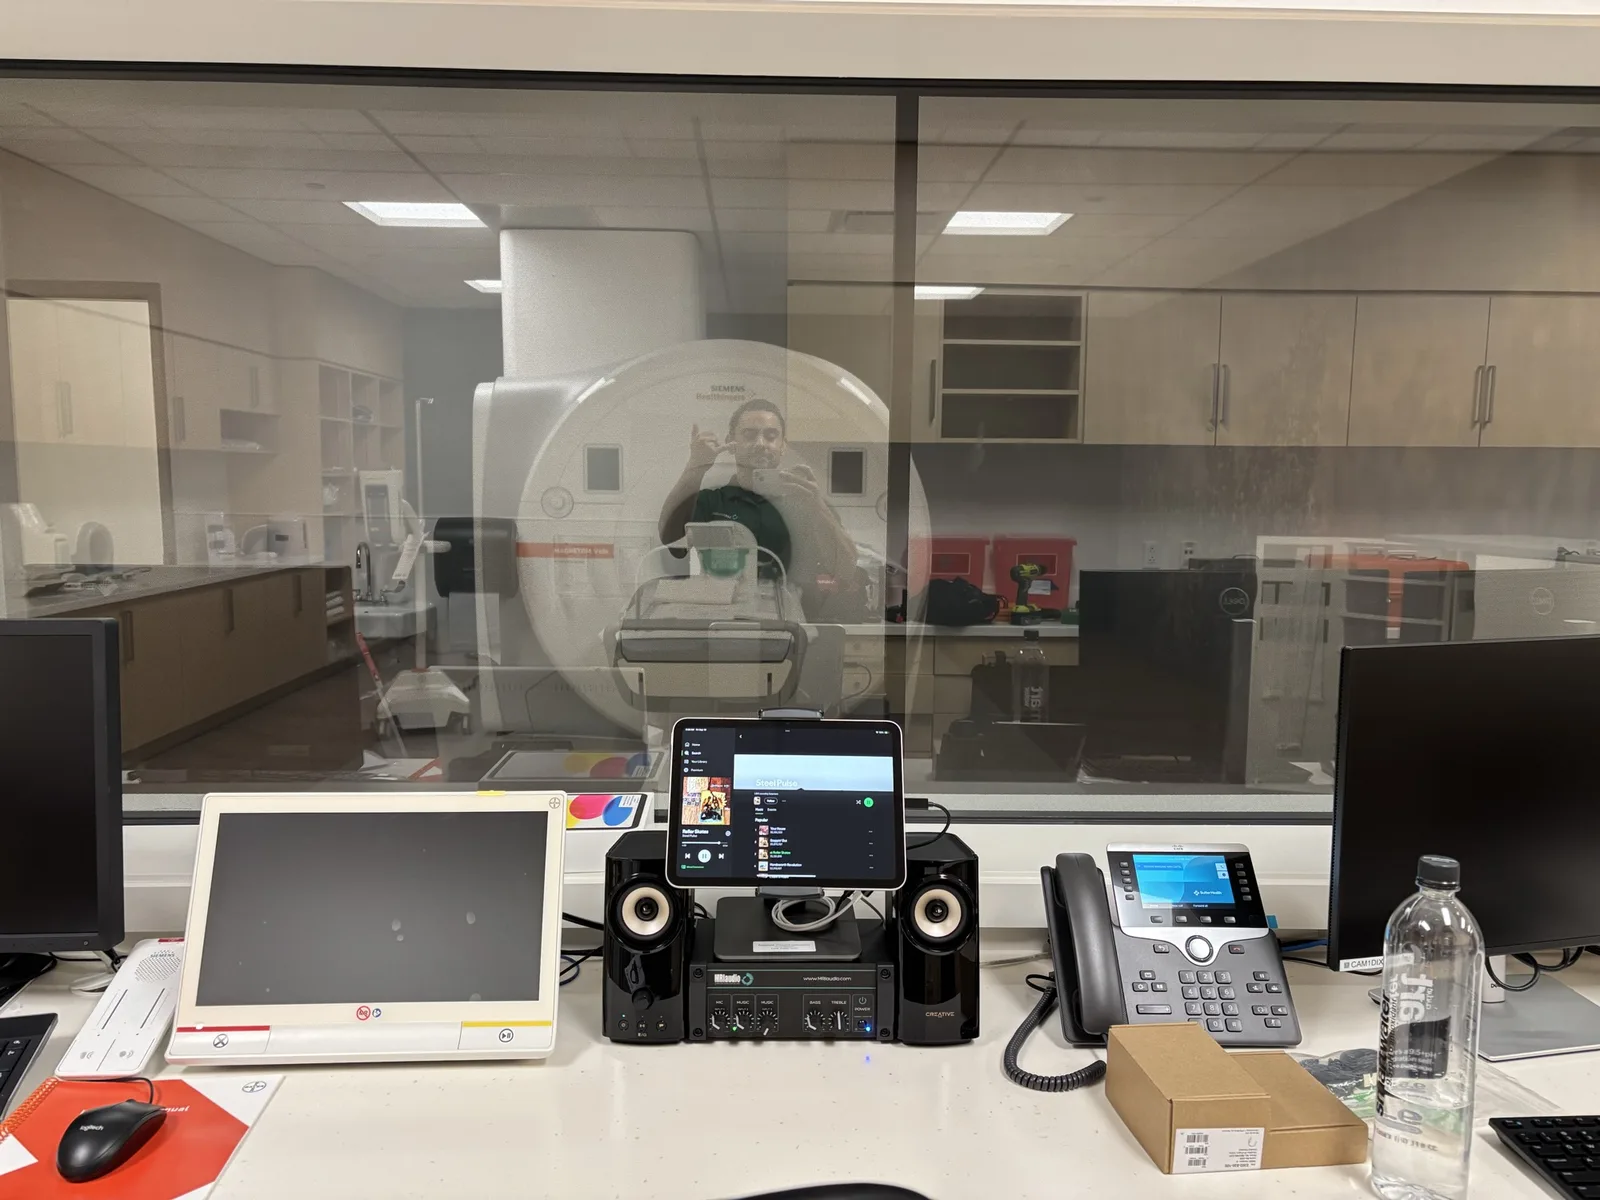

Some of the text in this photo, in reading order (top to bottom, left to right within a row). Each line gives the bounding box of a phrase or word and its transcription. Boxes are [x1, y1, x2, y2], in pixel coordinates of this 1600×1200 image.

[755, 778, 799, 787] Steel Pulse
[714, 973, 741, 983] MRIaudio
[1375, 989, 1391, 1117] smartwater
